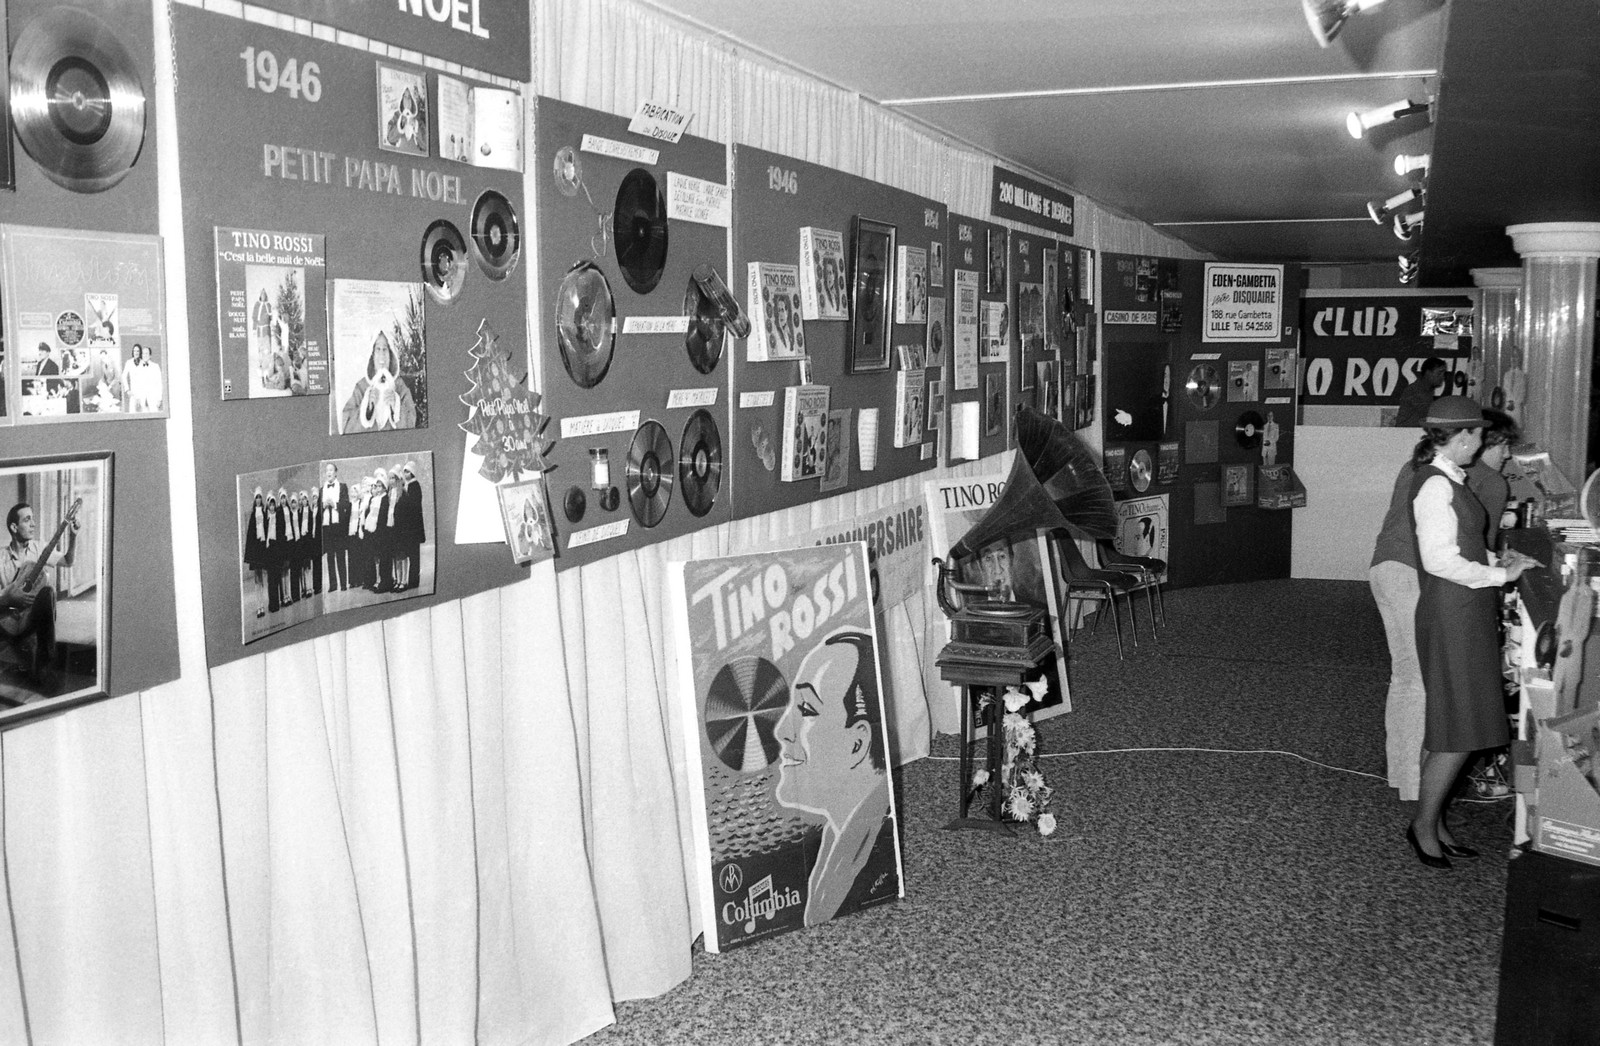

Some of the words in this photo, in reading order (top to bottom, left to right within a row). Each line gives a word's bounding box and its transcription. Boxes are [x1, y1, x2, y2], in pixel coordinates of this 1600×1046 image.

[240, 46, 322, 102] 1946
[263, 144, 336, 184] PETIT
[345, 157, 403, 195] PAPA
[412, 168, 467, 205] NOEL
[767, 166, 797, 194] 1946
[1000, 181, 1014, 204] 200
[232, 232, 270, 249] TINO
[273, 235, 313, 253] ROSSI
[246, 252, 254, 262] la
[256, 253, 276, 264] belle
[277, 255, 292, 265] nuit
[293, 256, 303, 265] de
[1213, 274, 1276, 288] EDEN-GAMBETTA
[1233, 290, 1275, 305] DISQUAIRE
[1106, 312, 1129, 322] CASINO
[1131, 312, 1140, 322] DE
[1141, 313, 1157, 323] PARIS
[1238, 310, 1272, 319] Gambetta
[1313, 307, 1399, 336] CLUB
[1211, 322, 1230, 331] LILLE
[502, 436, 515, 452] 30
[940, 483, 985, 509] TINO
[722, 887, 801, 926] Columbia
